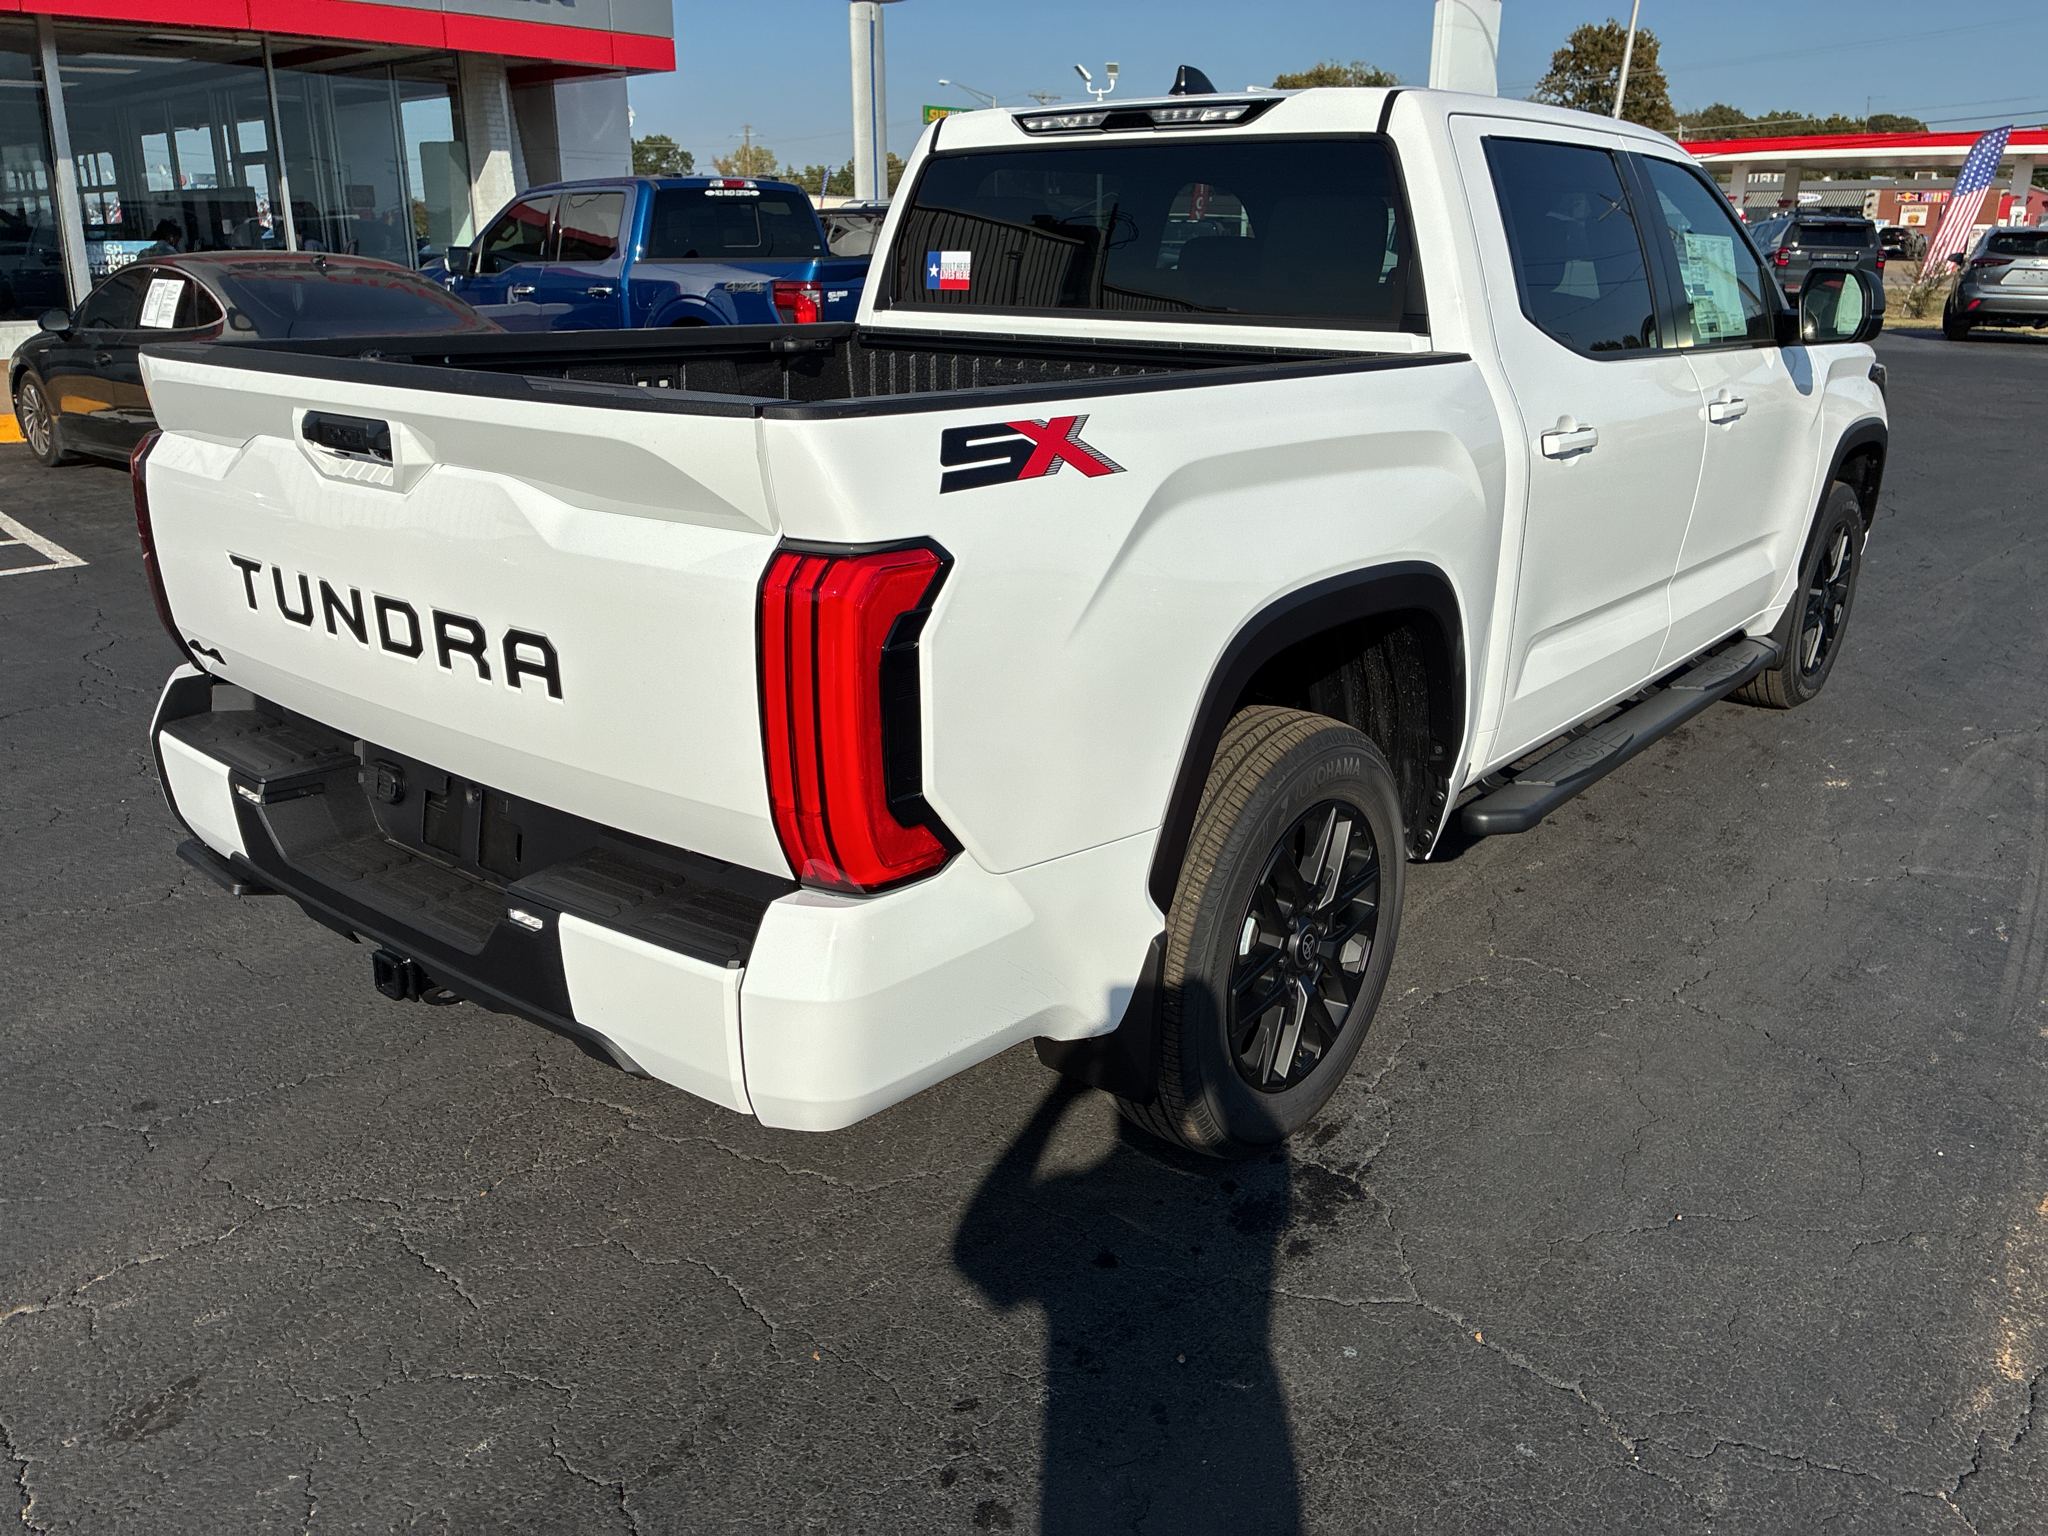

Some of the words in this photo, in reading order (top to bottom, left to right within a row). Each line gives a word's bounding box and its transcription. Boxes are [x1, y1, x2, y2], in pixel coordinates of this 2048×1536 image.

[940, 270, 956, 279] LIVES
[956, 271, 970, 279] HERE
[940, 414, 1128, 494] SX
[229, 553, 563, 701] TUNDRA
[1293, 757, 1361, 802] YOKOHAMA
